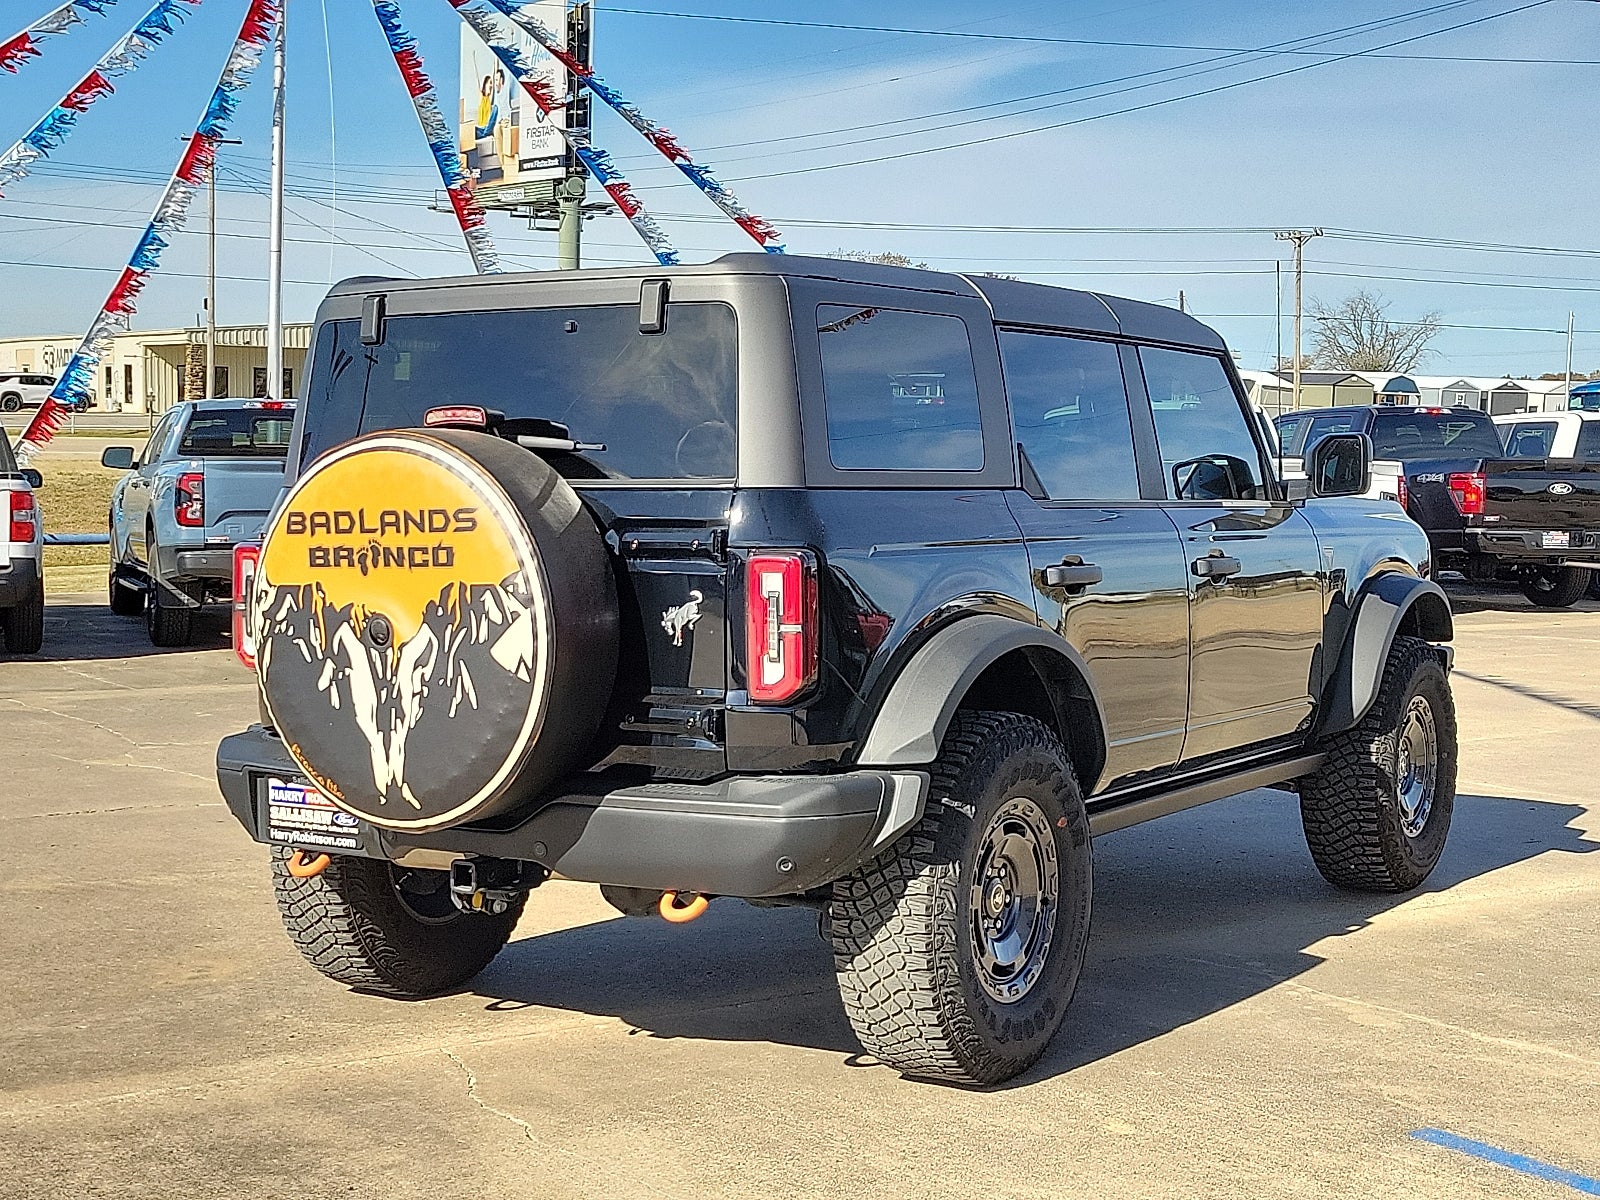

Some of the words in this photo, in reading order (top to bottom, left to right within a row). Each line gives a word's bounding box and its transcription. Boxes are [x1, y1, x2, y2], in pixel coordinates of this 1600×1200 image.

[526, 125, 555, 139] FIRSTAR
[531, 137, 549, 150] BANK
[286, 507, 478, 538] BADLANDS
[271, 788, 304, 803] HARRY
[270, 828, 357, 848] HarryRobinson.com
